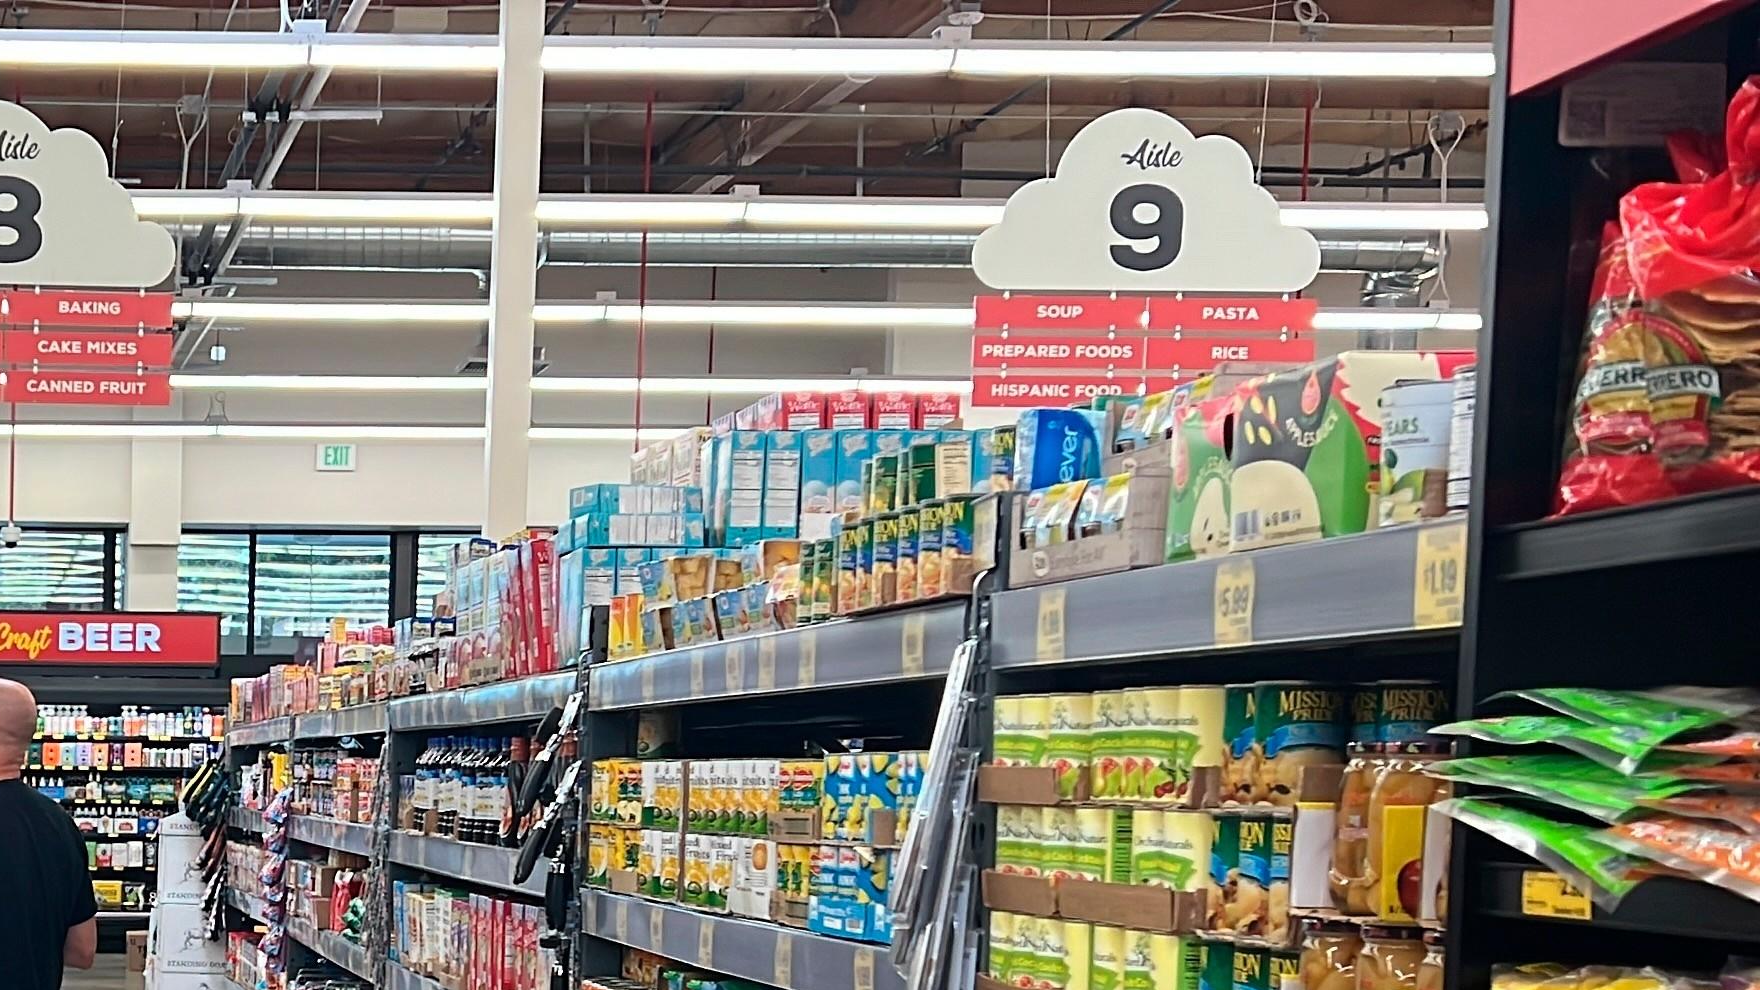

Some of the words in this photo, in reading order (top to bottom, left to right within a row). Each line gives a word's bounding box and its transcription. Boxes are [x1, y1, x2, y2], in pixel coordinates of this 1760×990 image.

[1121, 138, 1184, 171] Aisle
[1108, 183, 1185, 271] 9
[59, 301, 121, 314] BAKING
[1036, 305, 1083, 318] SOUP
[1203, 306, 1259, 321] PASTA
[38, 341, 81, 354] CAKE
[87, 341, 137, 354] MIXES
[982, 345, 1070, 358] PREPARED
[1075, 345, 1133, 359] FOODS
[1212, 346, 1248, 359] RICE
[27, 379, 94, 393] CANNED
[101, 381, 146, 394] FRUIT
[991, 383, 1069, 397] HISPANIC
[1073, 384, 1122, 397] FOOD
[324, 445, 351, 467] EXIT
[58, 622, 162, 652] BEER
